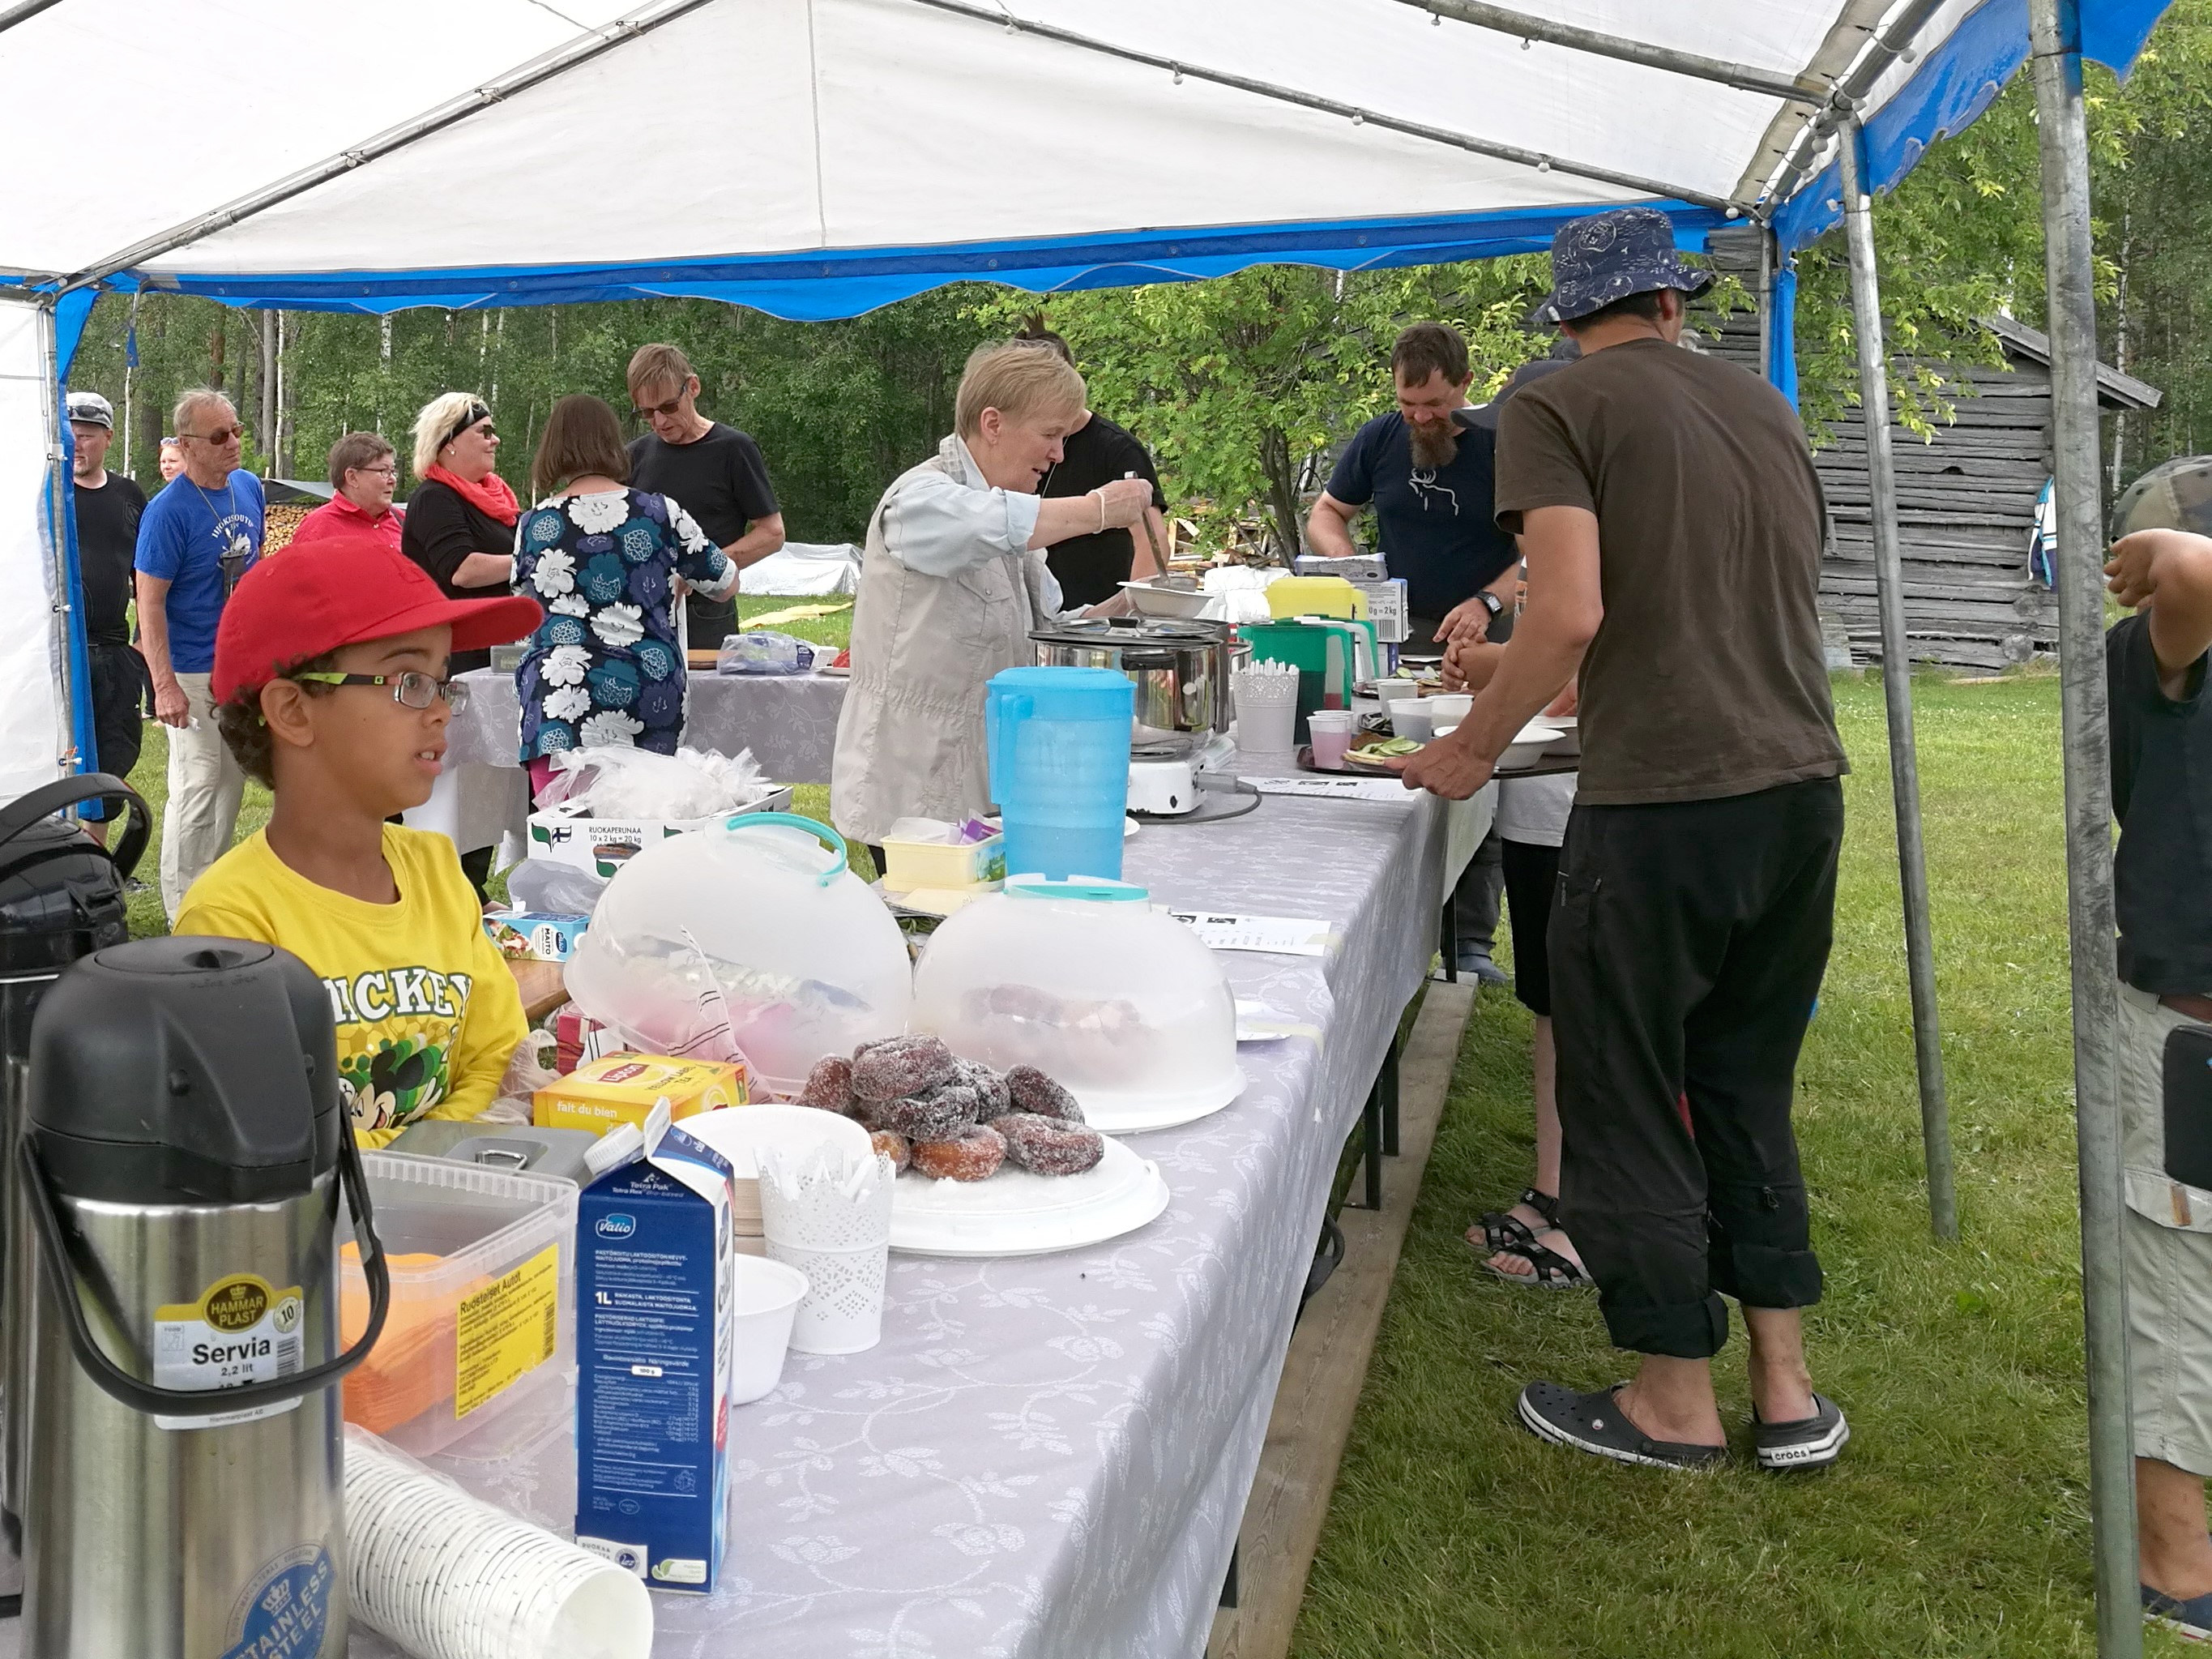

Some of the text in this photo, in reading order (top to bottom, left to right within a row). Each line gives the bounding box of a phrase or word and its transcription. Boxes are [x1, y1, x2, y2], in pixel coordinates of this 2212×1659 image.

[609, 835, 617, 844] kg
[634, 836, 642, 844] kg
[604, 1065, 645, 1082] Lipton
[557, 1101, 617, 1118] fait du bien
[630, 1181, 669, 1191] Tetra Pak
[599, 1222, 630, 1234] Valio
[595, 1291, 613, 1305] 1L
[211, 1296, 264, 1315] HAMMAR
[219, 1311, 257, 1326] PLAST
[281, 1305, 295, 1324] 10
[192, 1336, 271, 1365] Servia
[220, 1363, 254, 1377] 2,2 lit
[1774, 1450, 1807, 1460] crocs
